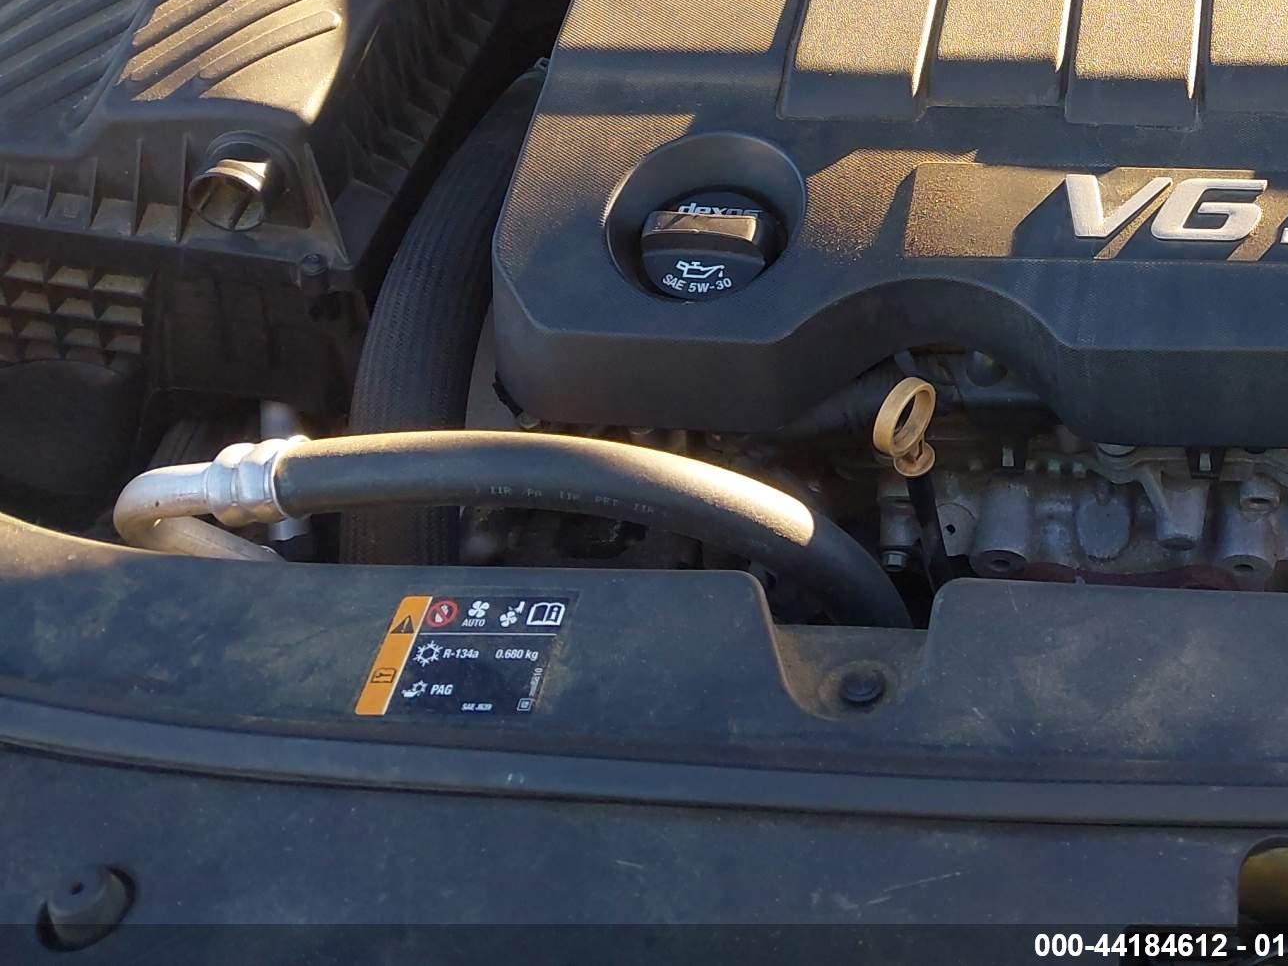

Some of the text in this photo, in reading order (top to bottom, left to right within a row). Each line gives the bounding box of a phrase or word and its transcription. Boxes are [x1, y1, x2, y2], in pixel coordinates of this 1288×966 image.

[1065, 173, 1269, 241] V6
[662, 273, 732, 294] SAE 5W-30
[461, 618, 486, 627] AUTO
[443, 649, 480, 659] R-134a
[524, 650, 539, 662] kg
[430, 684, 453, 695] PAG
